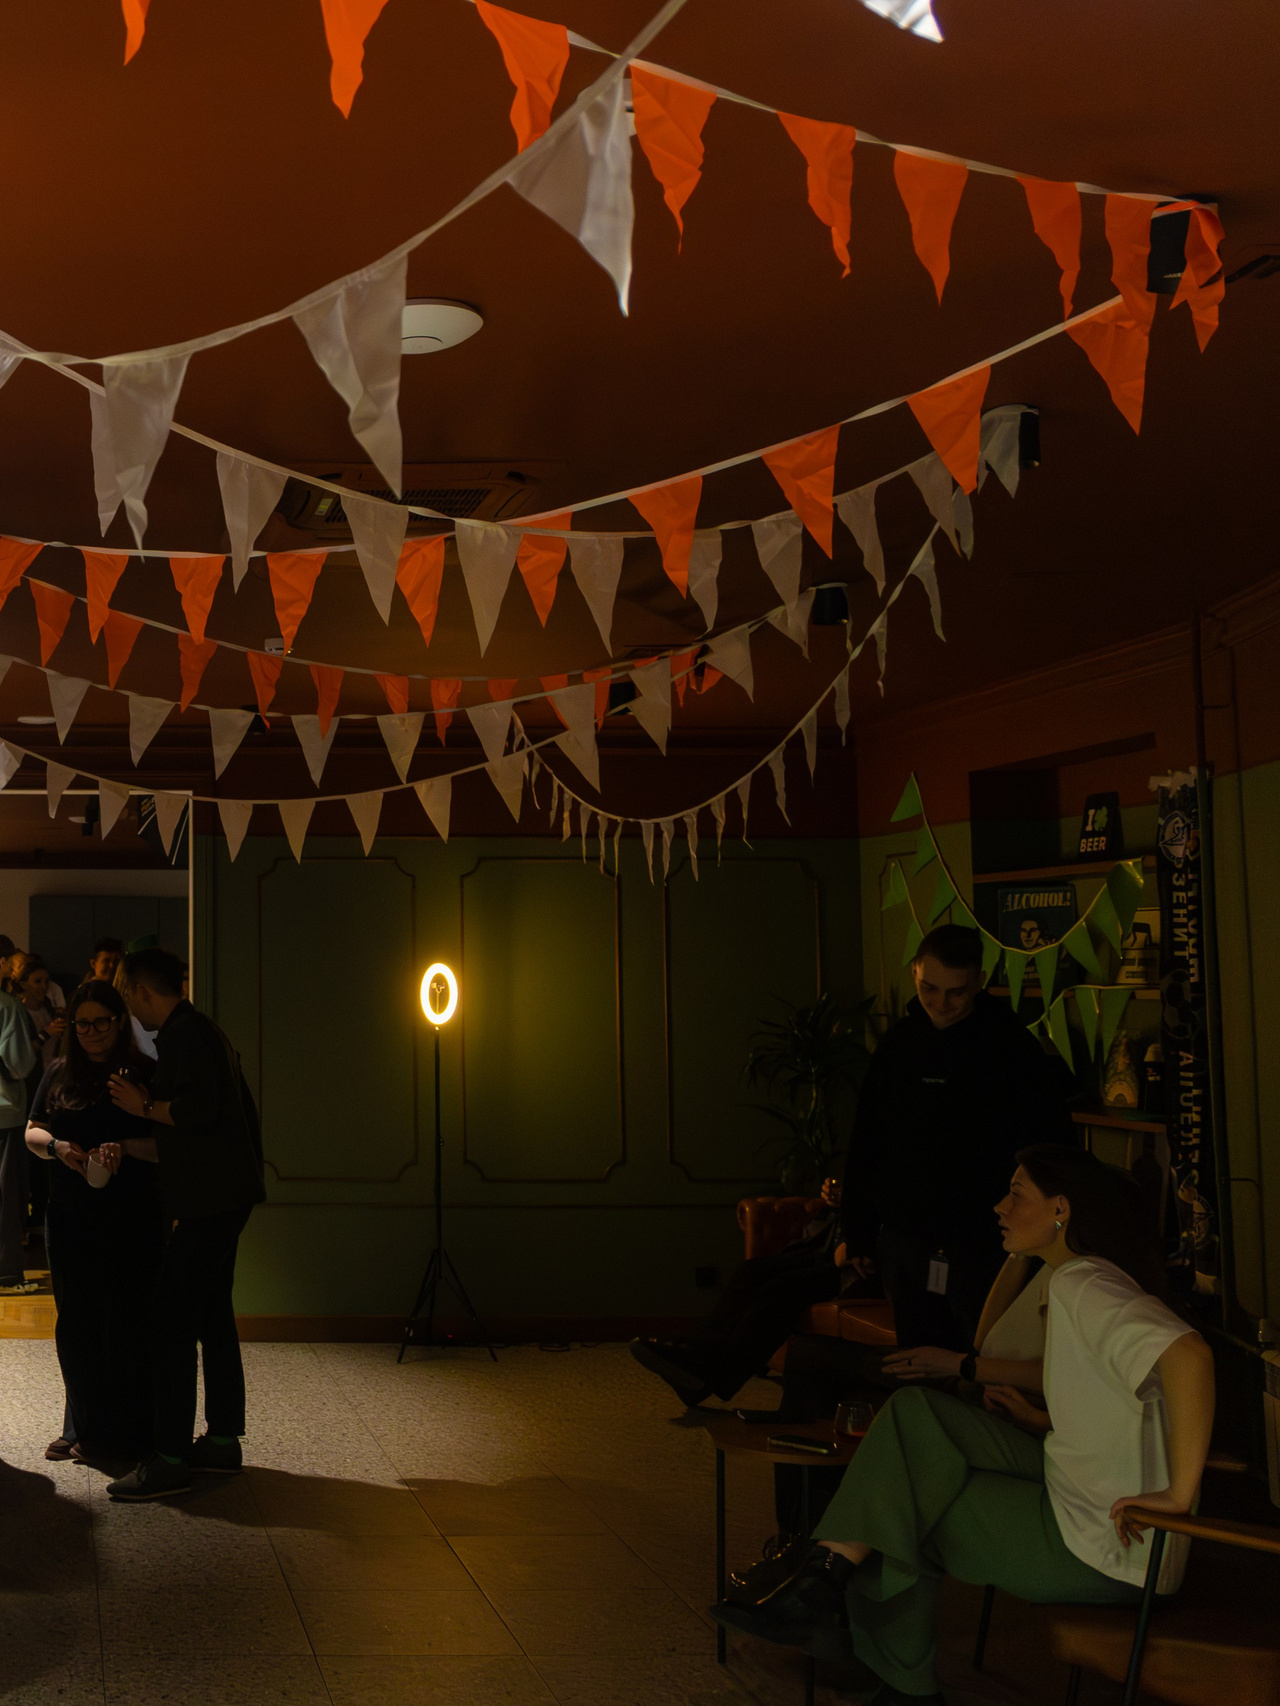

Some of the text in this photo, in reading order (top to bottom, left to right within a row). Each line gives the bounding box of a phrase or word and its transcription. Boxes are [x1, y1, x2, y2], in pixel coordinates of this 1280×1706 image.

[1085, 808, 1095, 831] I
[1079, 836, 1107, 853] BEER
[1003, 892, 1071, 912] ALCOHOL!
[1172, 872, 1189, 961] ЗЕНИТ
